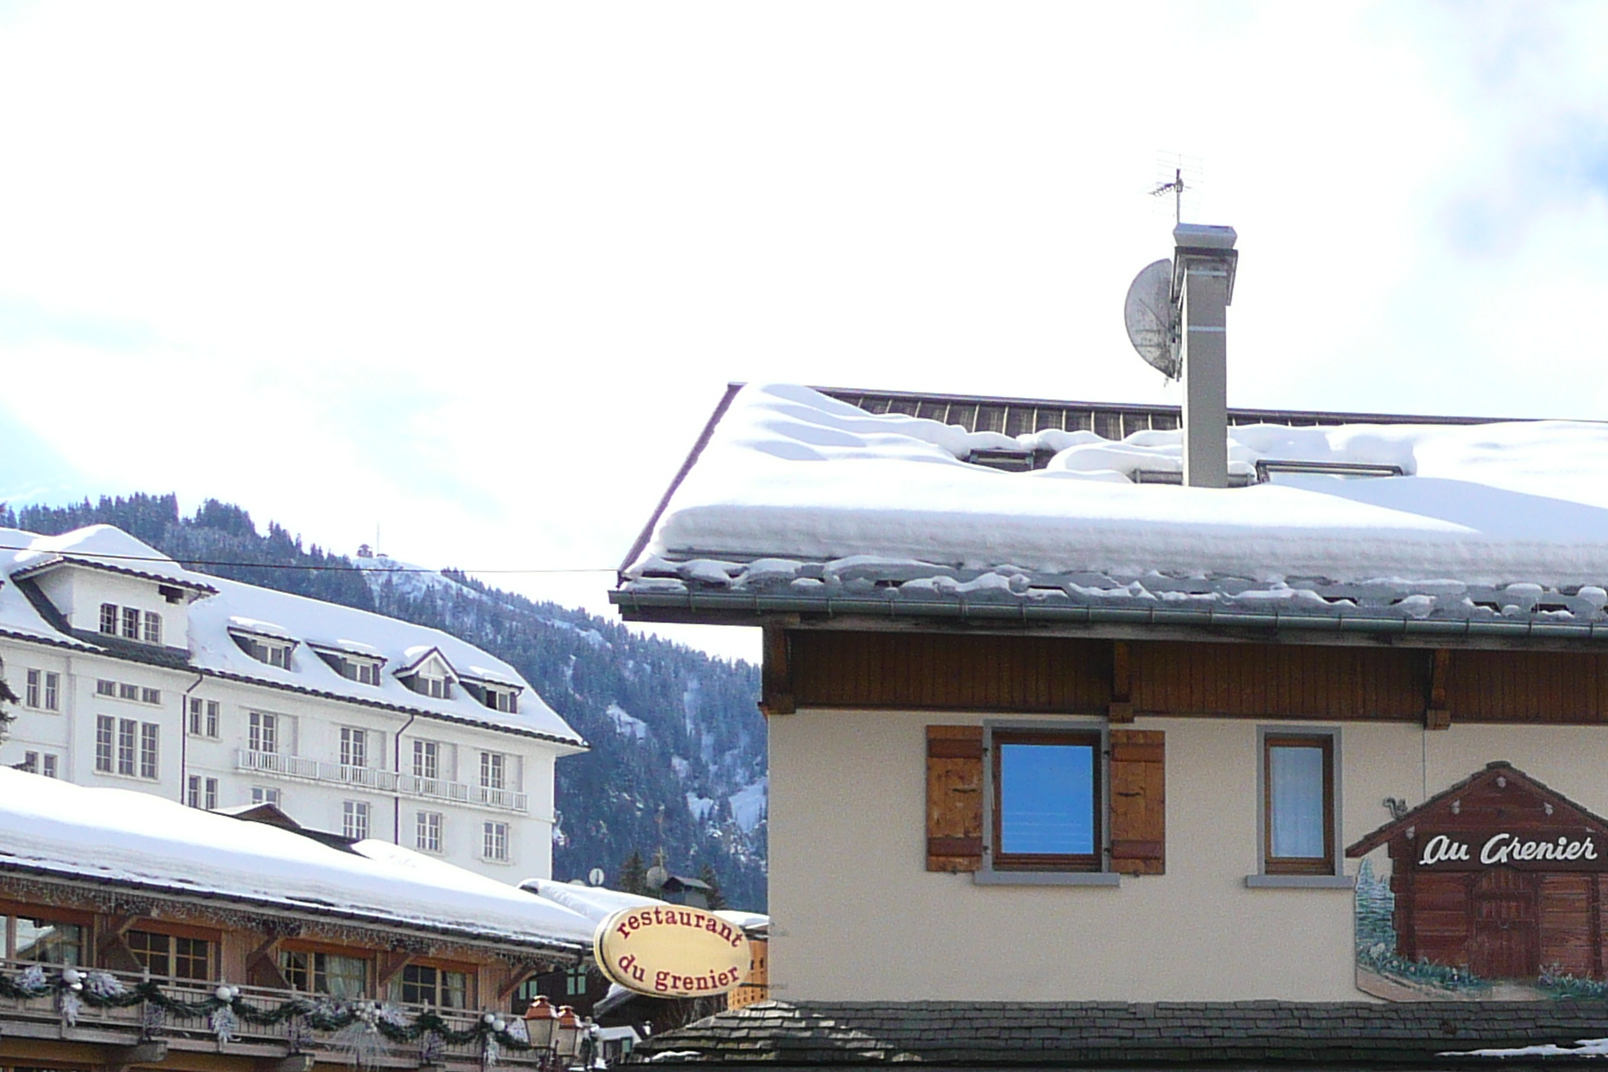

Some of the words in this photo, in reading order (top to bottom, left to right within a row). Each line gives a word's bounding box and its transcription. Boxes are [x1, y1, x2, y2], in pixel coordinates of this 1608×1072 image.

[1419, 835, 1470, 865] Au
[1480, 833, 1598, 864] Grenier
[616, 906, 743, 948] restaurant
[618, 954, 645, 982] du
[655, 965, 740, 992] grenier
